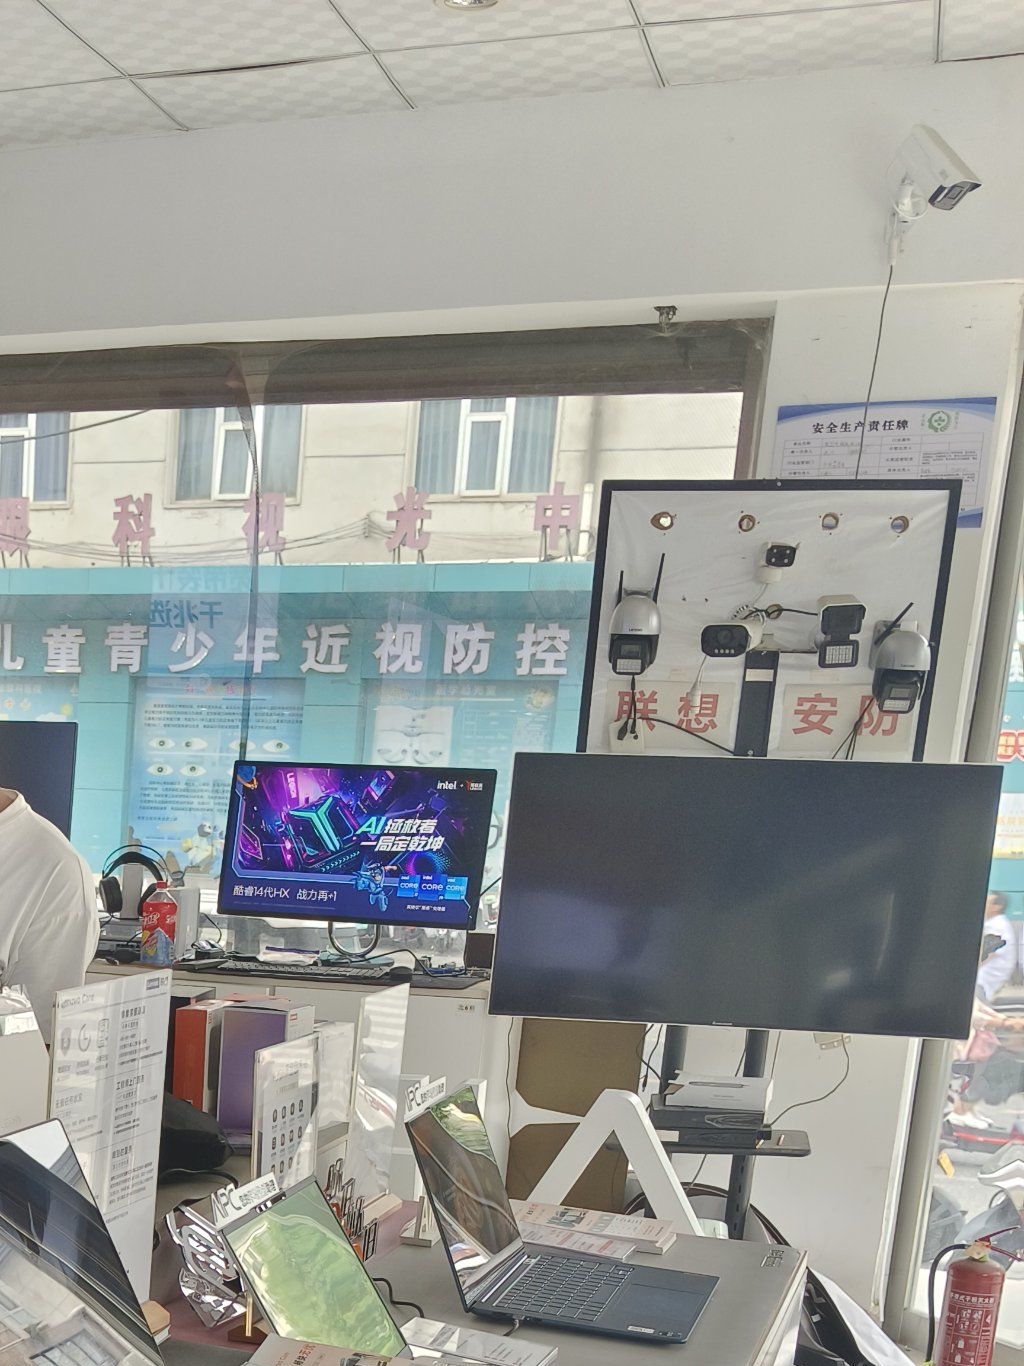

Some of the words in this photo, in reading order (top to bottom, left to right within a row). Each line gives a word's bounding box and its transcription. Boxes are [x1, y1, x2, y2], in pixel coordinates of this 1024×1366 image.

[812, 419, 910, 434] 安全生产责任牌
[615, 691, 719, 734] 联想
[792, 692, 901, 737] 安防
[437, 780, 457, 790] intel
[355, 816, 437, 834] AI拯救者
[360, 836, 445, 851] 一局定乾坤
[233, 885, 290, 898] 酷睿14代HX
